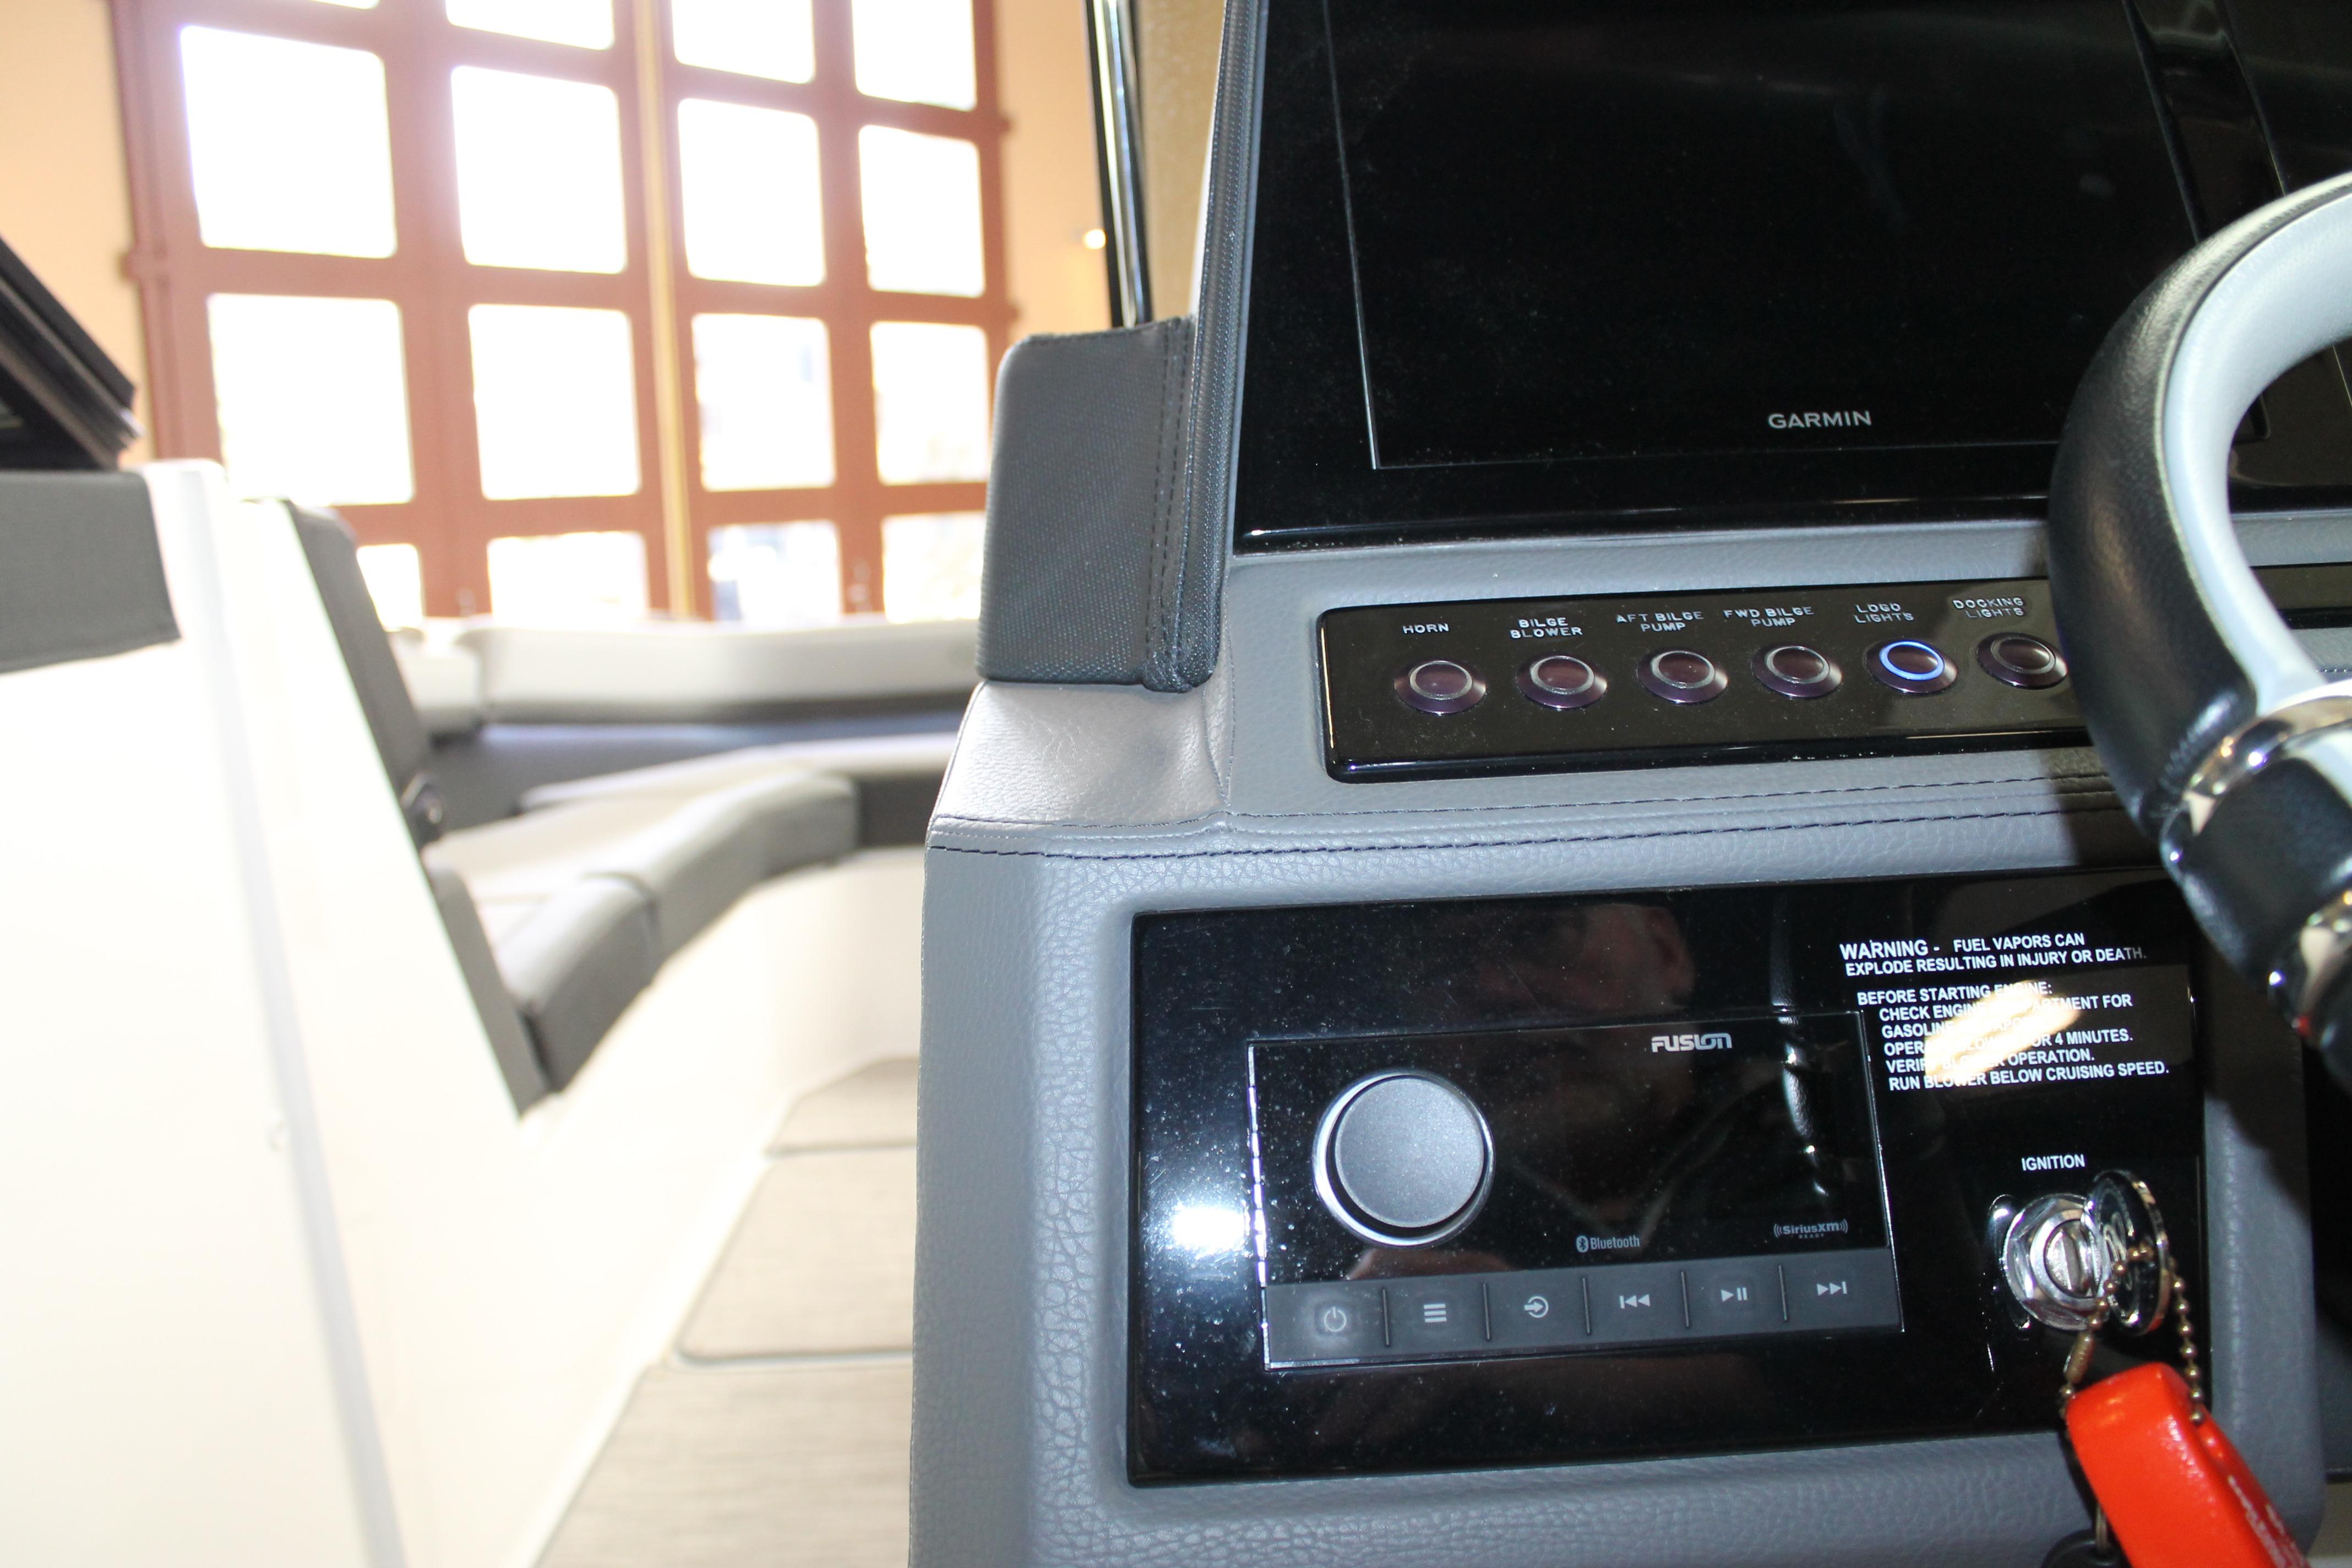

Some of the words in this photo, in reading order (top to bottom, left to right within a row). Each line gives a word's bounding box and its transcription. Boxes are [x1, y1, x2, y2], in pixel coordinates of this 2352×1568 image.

[1768, 411, 1871, 429] GARMIN
[1856, 603, 1901, 613] LOGO
[1953, 597, 2023, 609] DOCKING
[1616, 614, 1647, 623] AFT
[1655, 612, 1703, 622] BILGE
[1723, 609, 1760, 618] FWD
[1765, 607, 1814, 617] BILGE
[1854, 612, 1914, 623] LIGHTS
[1966, 607, 2023, 618] LIGHTS
[1403, 623, 1449, 634] HORN
[1518, 617, 1568, 628] BILGE
[1641, 622, 1686, 632] PUMP
[1751, 617, 1795, 627] PUMP
[1510, 627, 1583, 639] BLOWER
[1839, 939, 1929, 960] WARNING
[1953, 938, 1991, 952] FUEL
[1992, 934, 2052, 950] VAPORS
[2055, 933, 2085, 947] CAN
[1845, 961, 1914, 977] EXPLODE
[1916, 955, 1997, 972] RESULTING
[2000, 954, 2015, 967] IN
[2017, 950, 2067, 966] INJURY
[2071, 949, 2093, 963] OR
[2095, 946, 2147, 961] DEATH.
[1857, 989, 1917, 1006] BEFORE
[1920, 986, 1991, 1001] STARTING
[1879, 1005, 1931, 1022] CHECK
[2103, 994, 2132, 1008] FOR
[1651, 1033, 1732, 1053] FUSION
[2055, 1035, 2063, 1045] 4
[2067, 1029, 2133, 1044] MINUTES.
[2008, 1048, 2094, 1066] OPERATION.
[1888, 1075, 1920, 1091] RUN
[1924, 1072, 1988, 1089] BLOWER
[1990, 1068, 2041, 1086] BELOW
[2045, 1064, 2114, 1081] CRUISING
[2118, 1060, 2169, 1076] SPEED.
[2021, 1154, 2086, 1171] IGNITION
[1589, 1235, 1640, 1250] Bluetooth
